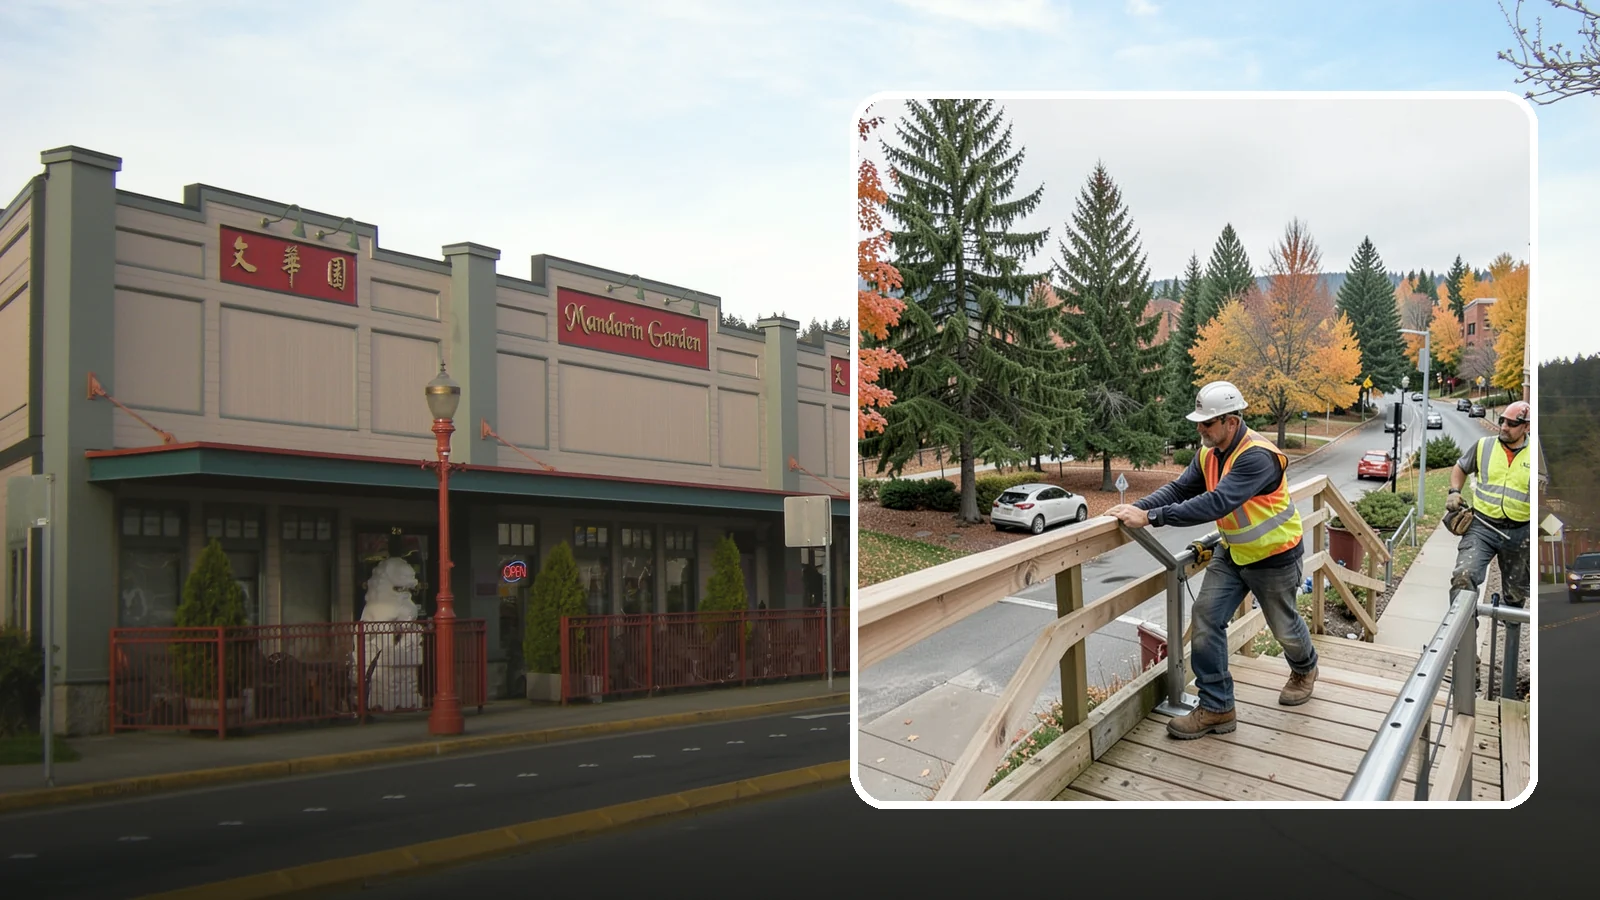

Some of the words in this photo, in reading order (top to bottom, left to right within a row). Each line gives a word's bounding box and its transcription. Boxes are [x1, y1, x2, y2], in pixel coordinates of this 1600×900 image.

[564, 302, 644, 340] Mandarin
[648, 320, 701, 352] Garden
[503, 565, 527, 578] OPEN
